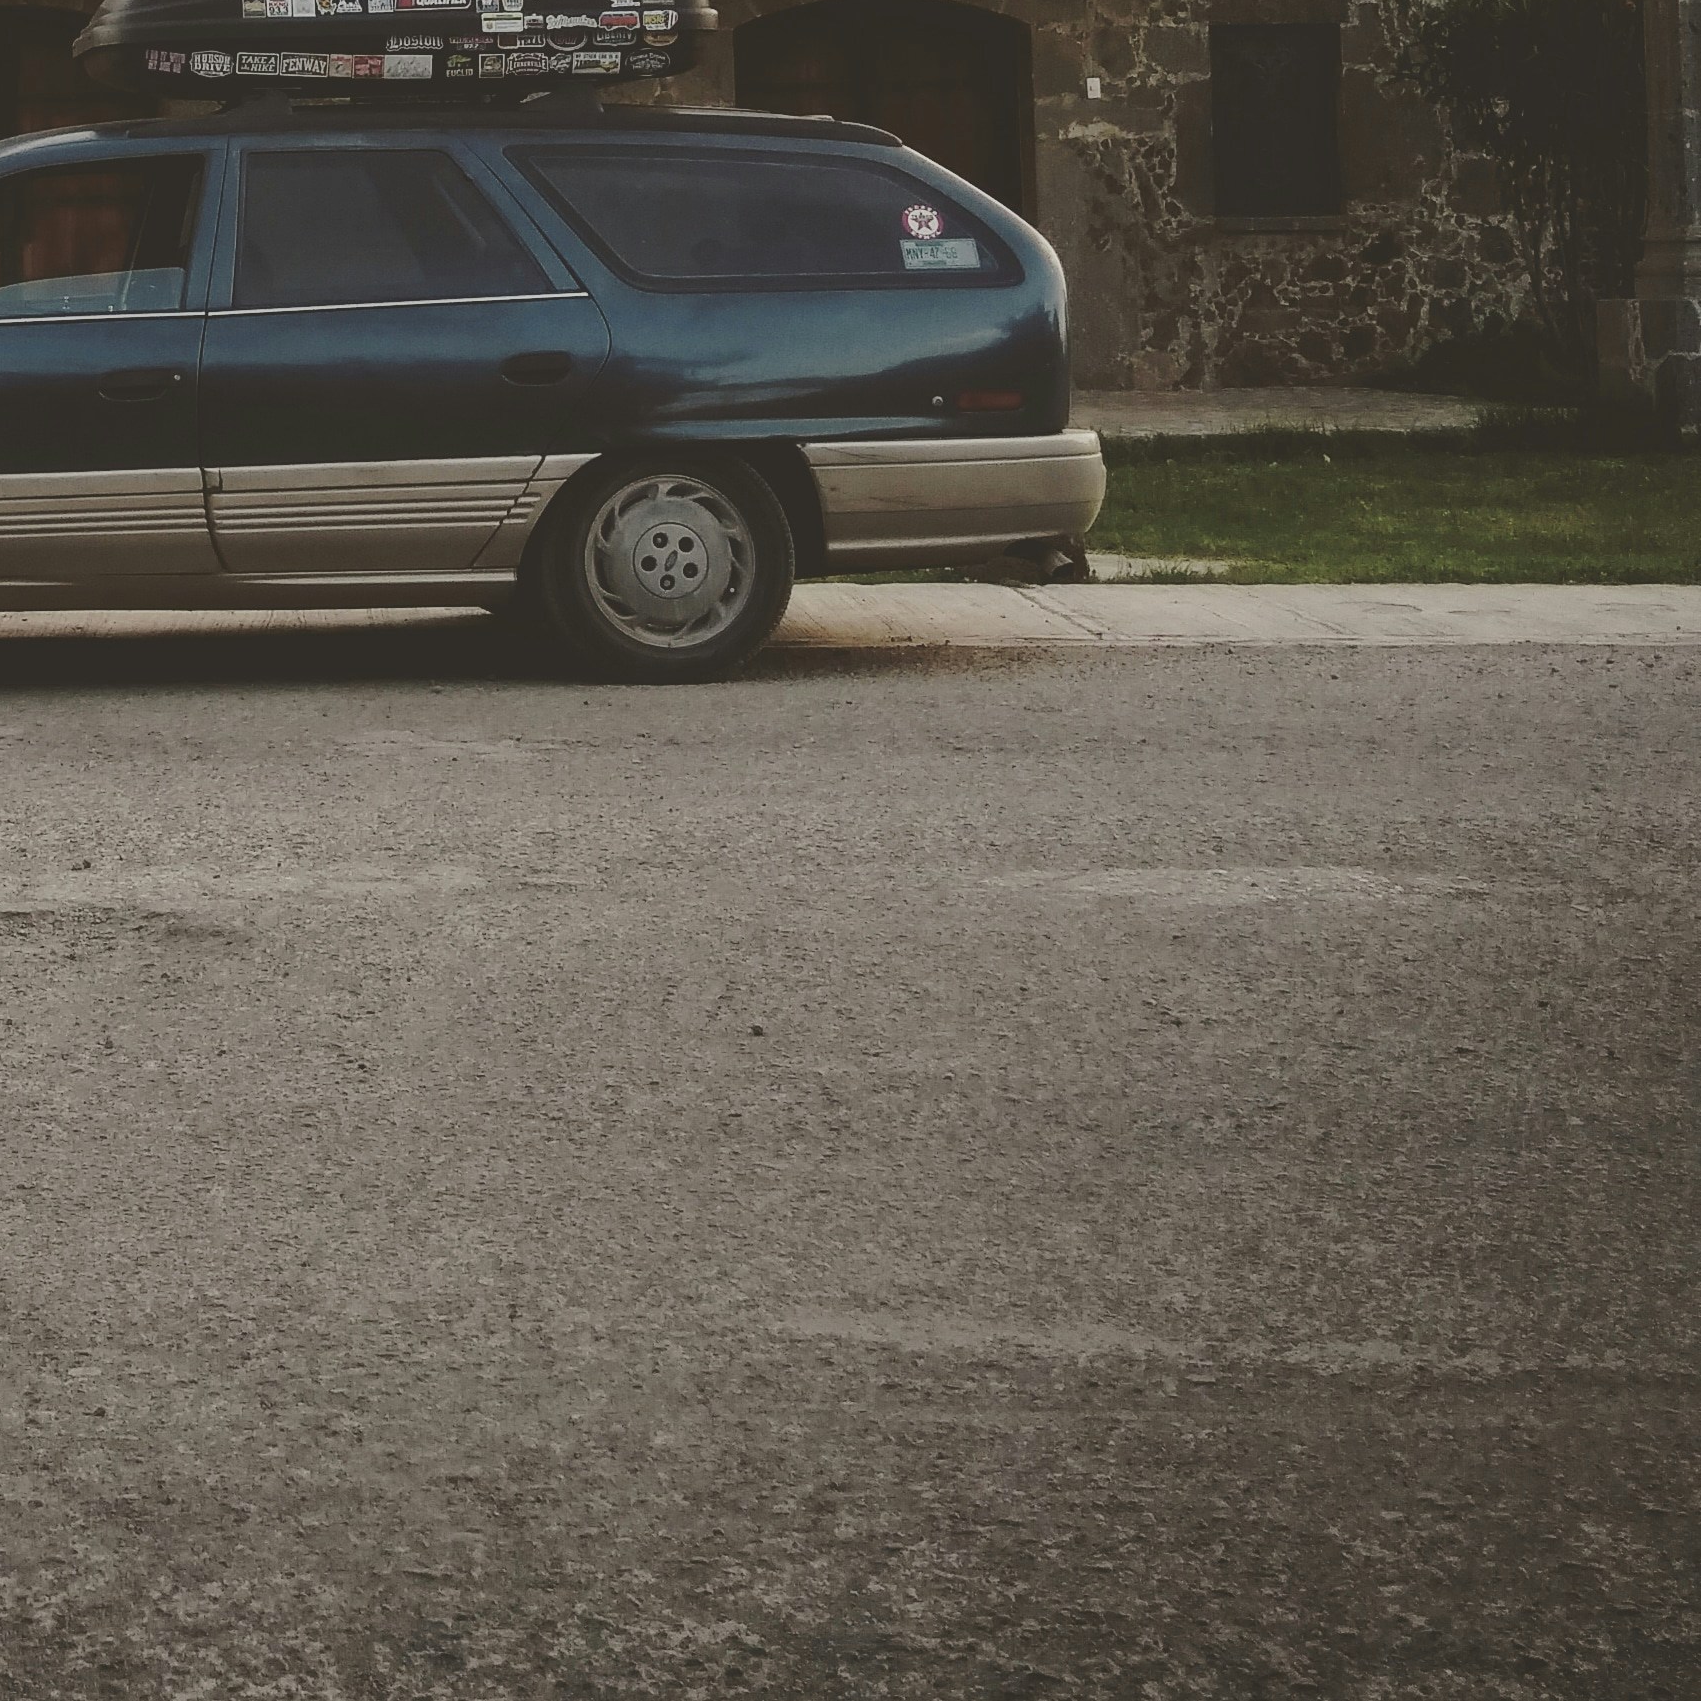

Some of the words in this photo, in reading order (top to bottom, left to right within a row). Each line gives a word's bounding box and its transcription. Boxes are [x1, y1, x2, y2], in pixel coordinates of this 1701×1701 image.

[195, 54, 231, 63] HUDSON
[241, 56, 267, 64] TAKE
[268, 57, 276, 65] A
[194, 62, 231, 72] DRIVE
[250, 64, 276, 72] HIKE
[282, 58, 327, 74] FENWAY
[446, 69, 474, 77] EUCLID
